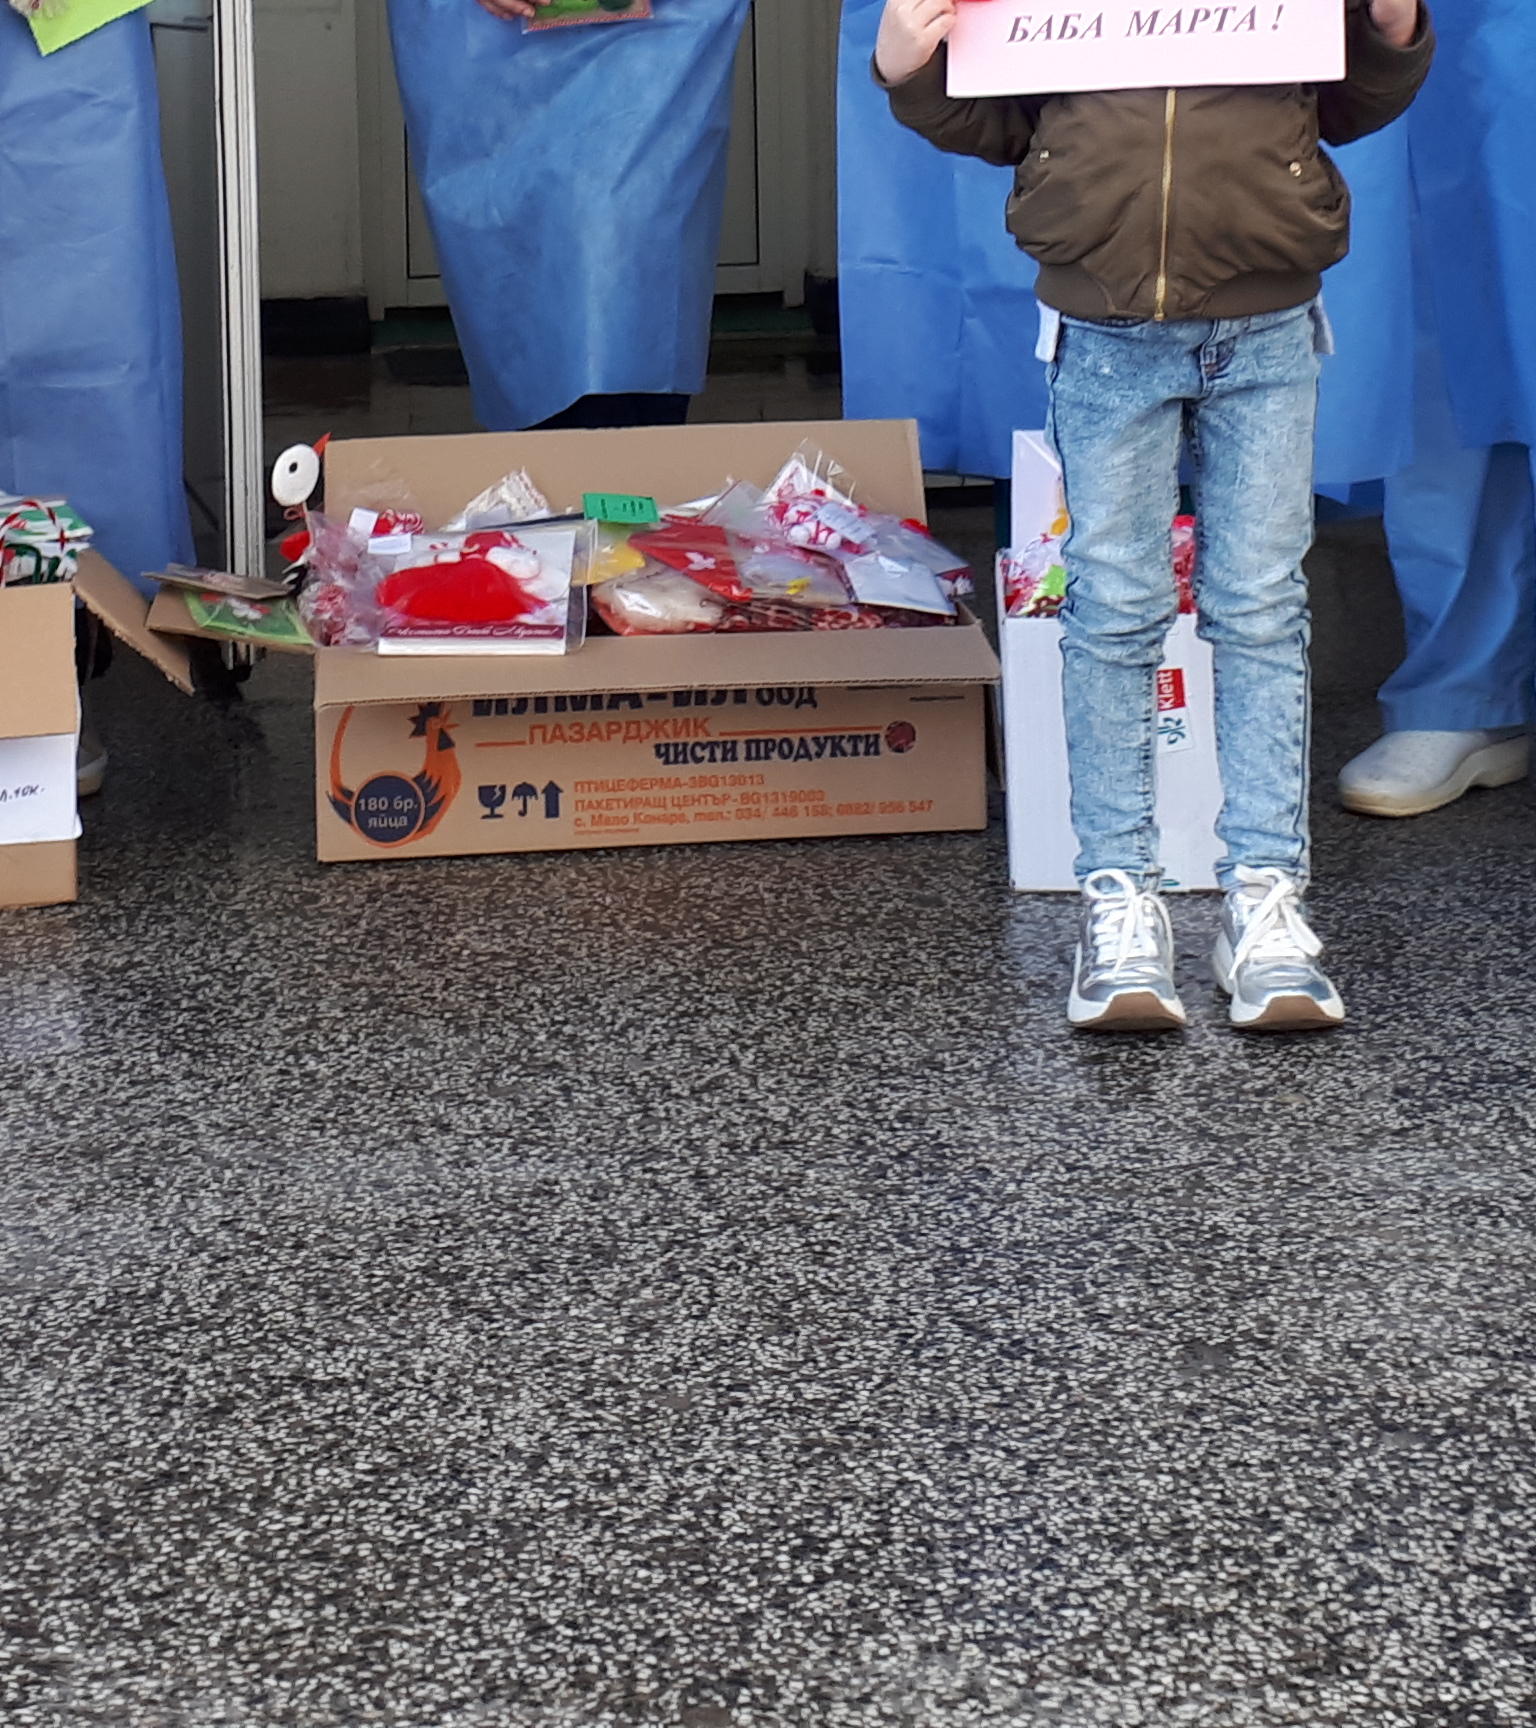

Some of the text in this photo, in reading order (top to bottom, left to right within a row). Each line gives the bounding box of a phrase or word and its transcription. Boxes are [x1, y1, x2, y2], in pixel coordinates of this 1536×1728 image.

[1006, 11, 1104, 44] БАБА
[1124, 4, 1258, 39] МАРТА
[1157, 670, 1175, 710] Klett
[529, 717, 712, 747] ПАЗАРДЖИК
[654, 733, 882, 766] ЧИСТИ ПРОДУКТИ
[358, 794, 418, 813] 180 бр.
[368, 813, 408, 829] яйца
